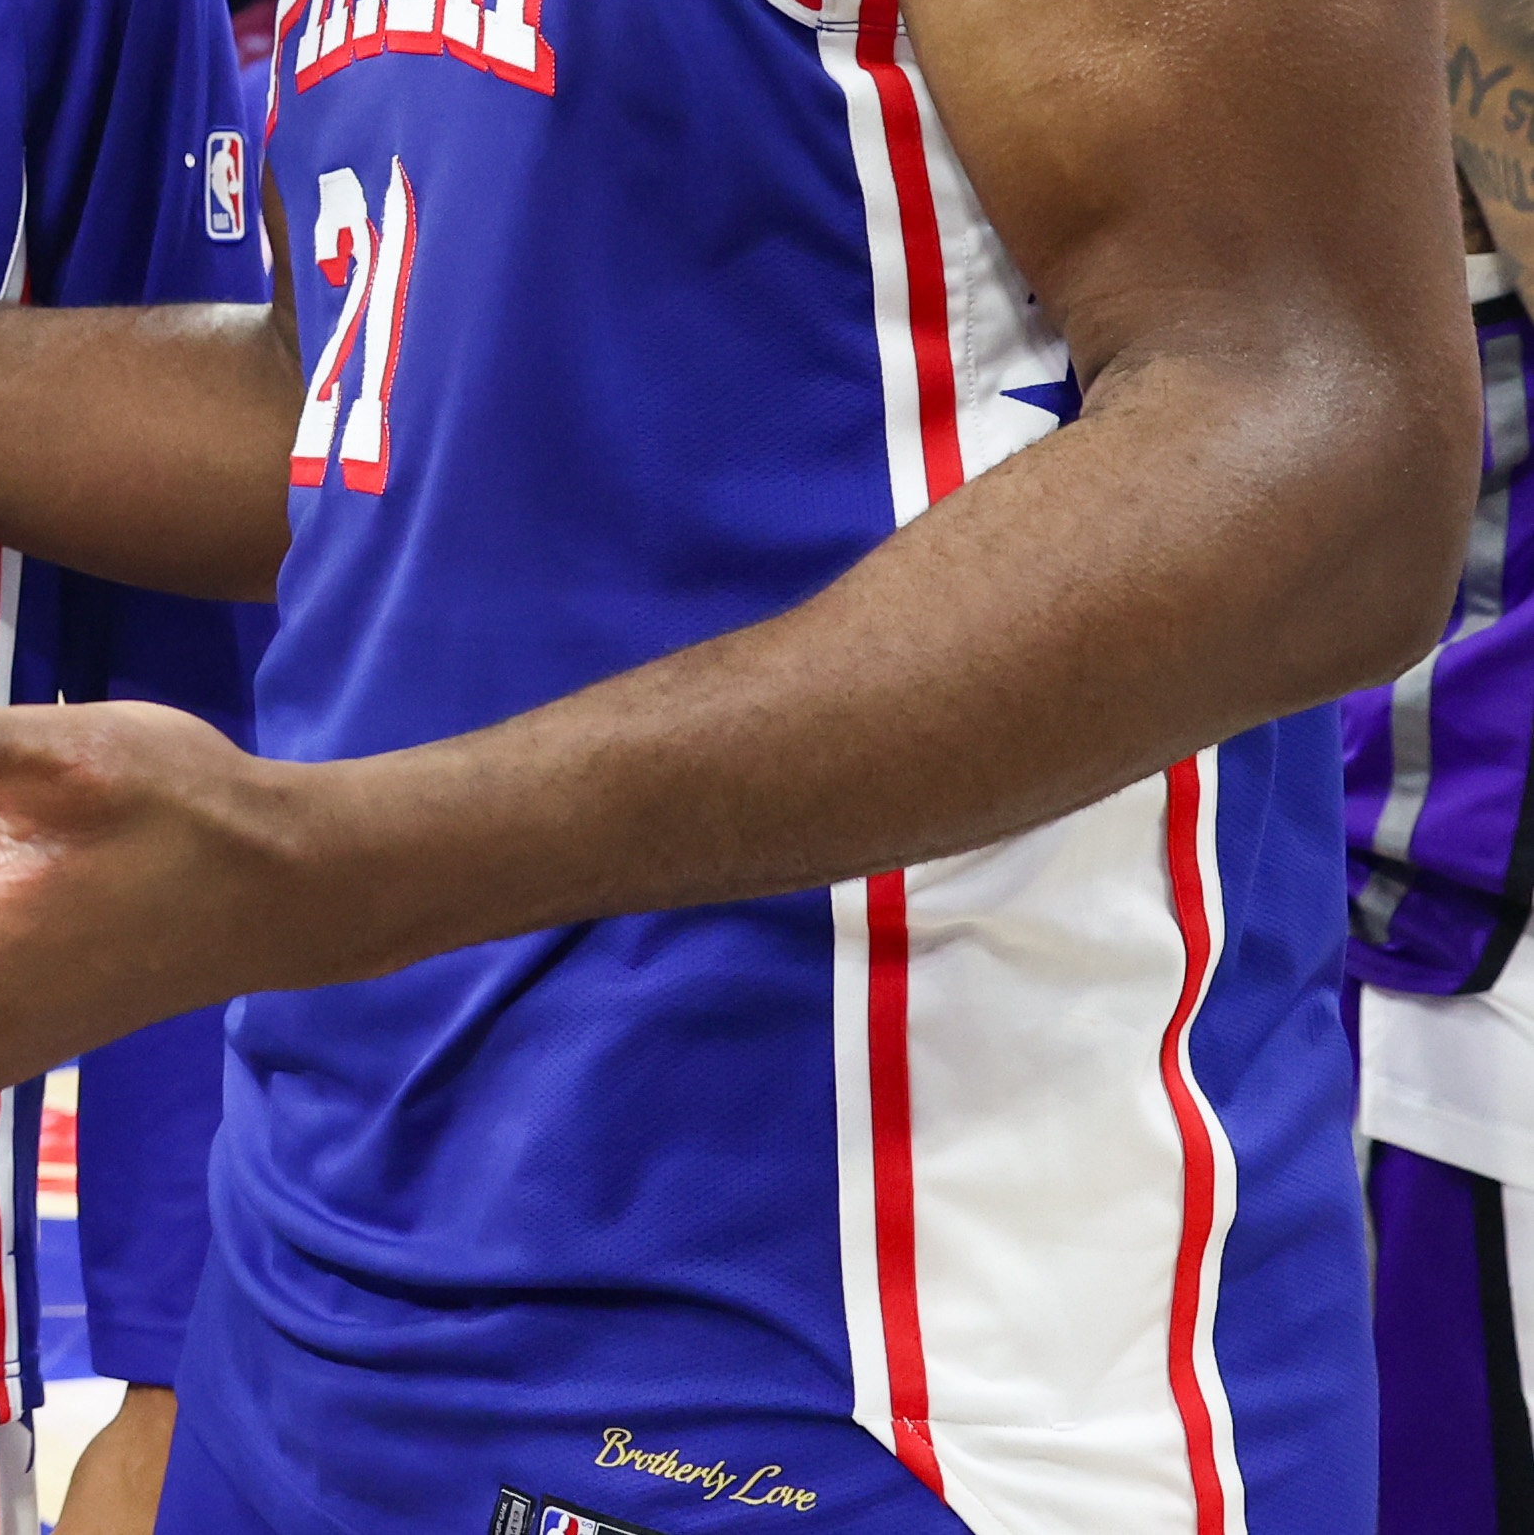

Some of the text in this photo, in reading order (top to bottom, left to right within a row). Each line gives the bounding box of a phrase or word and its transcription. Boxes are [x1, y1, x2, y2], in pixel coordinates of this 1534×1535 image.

[289, 154, 417, 496] 21
[593, 1427, 818, 1512] Brotherly Love
